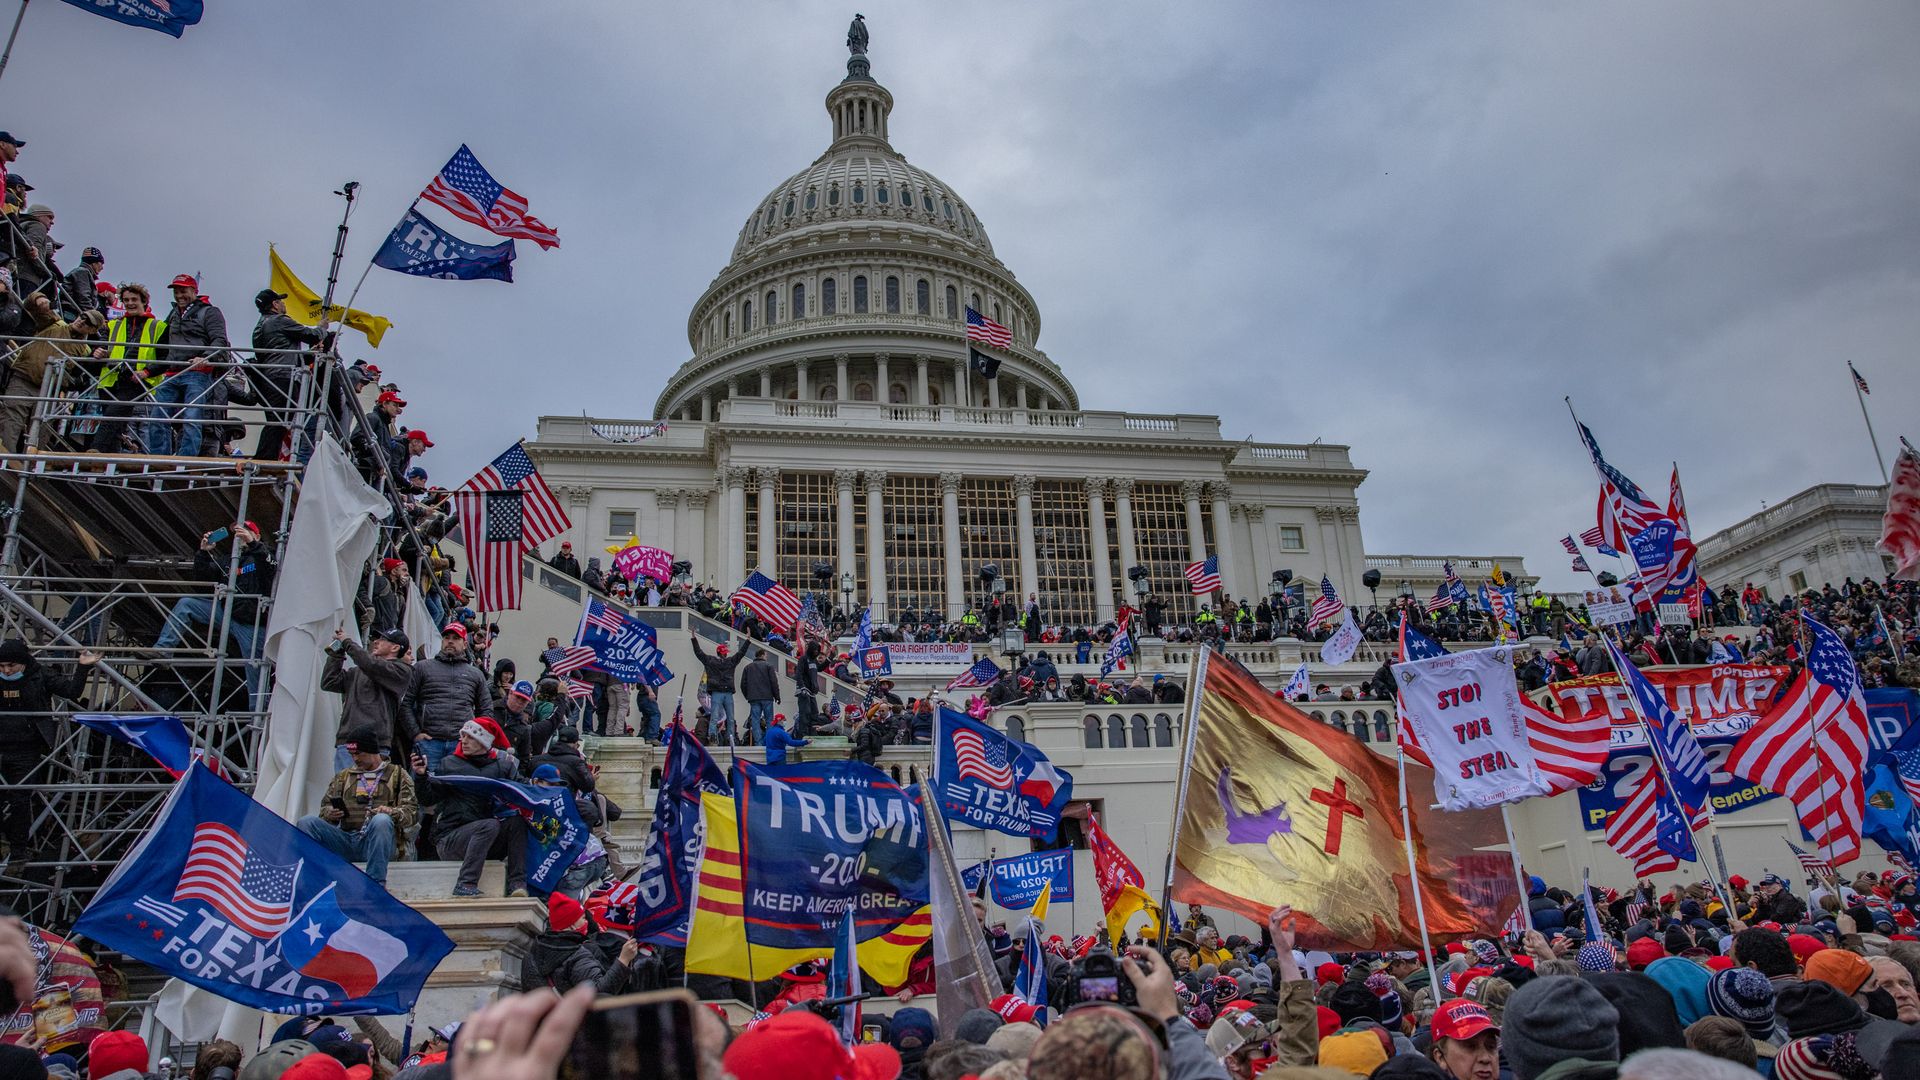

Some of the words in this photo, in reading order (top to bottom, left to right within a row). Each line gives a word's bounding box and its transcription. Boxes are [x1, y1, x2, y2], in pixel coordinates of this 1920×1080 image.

[866, 653, 882, 662] STOP
[908, 644, 928, 653] FIGHT
[929, 644, 944, 653] FOR
[946, 643, 968, 653] TRUMP
[1430, 658, 1455, 669] Trump
[1712, 666, 1770, 679] Donald
[1453, 717, 1493, 744] THE
[973, 782, 1031, 821] TEXAS
[1482, 790, 1506, 802] Trump
[756, 775, 921, 849] TRUMP
[965, 806, 994, 825] FOR
[995, 815, 1031, 833] TRUMP
[753, 888, 803, 912] KEEP
[161, 936, 222, 980] FOR
[189, 908, 330, 1000] TEXAS
